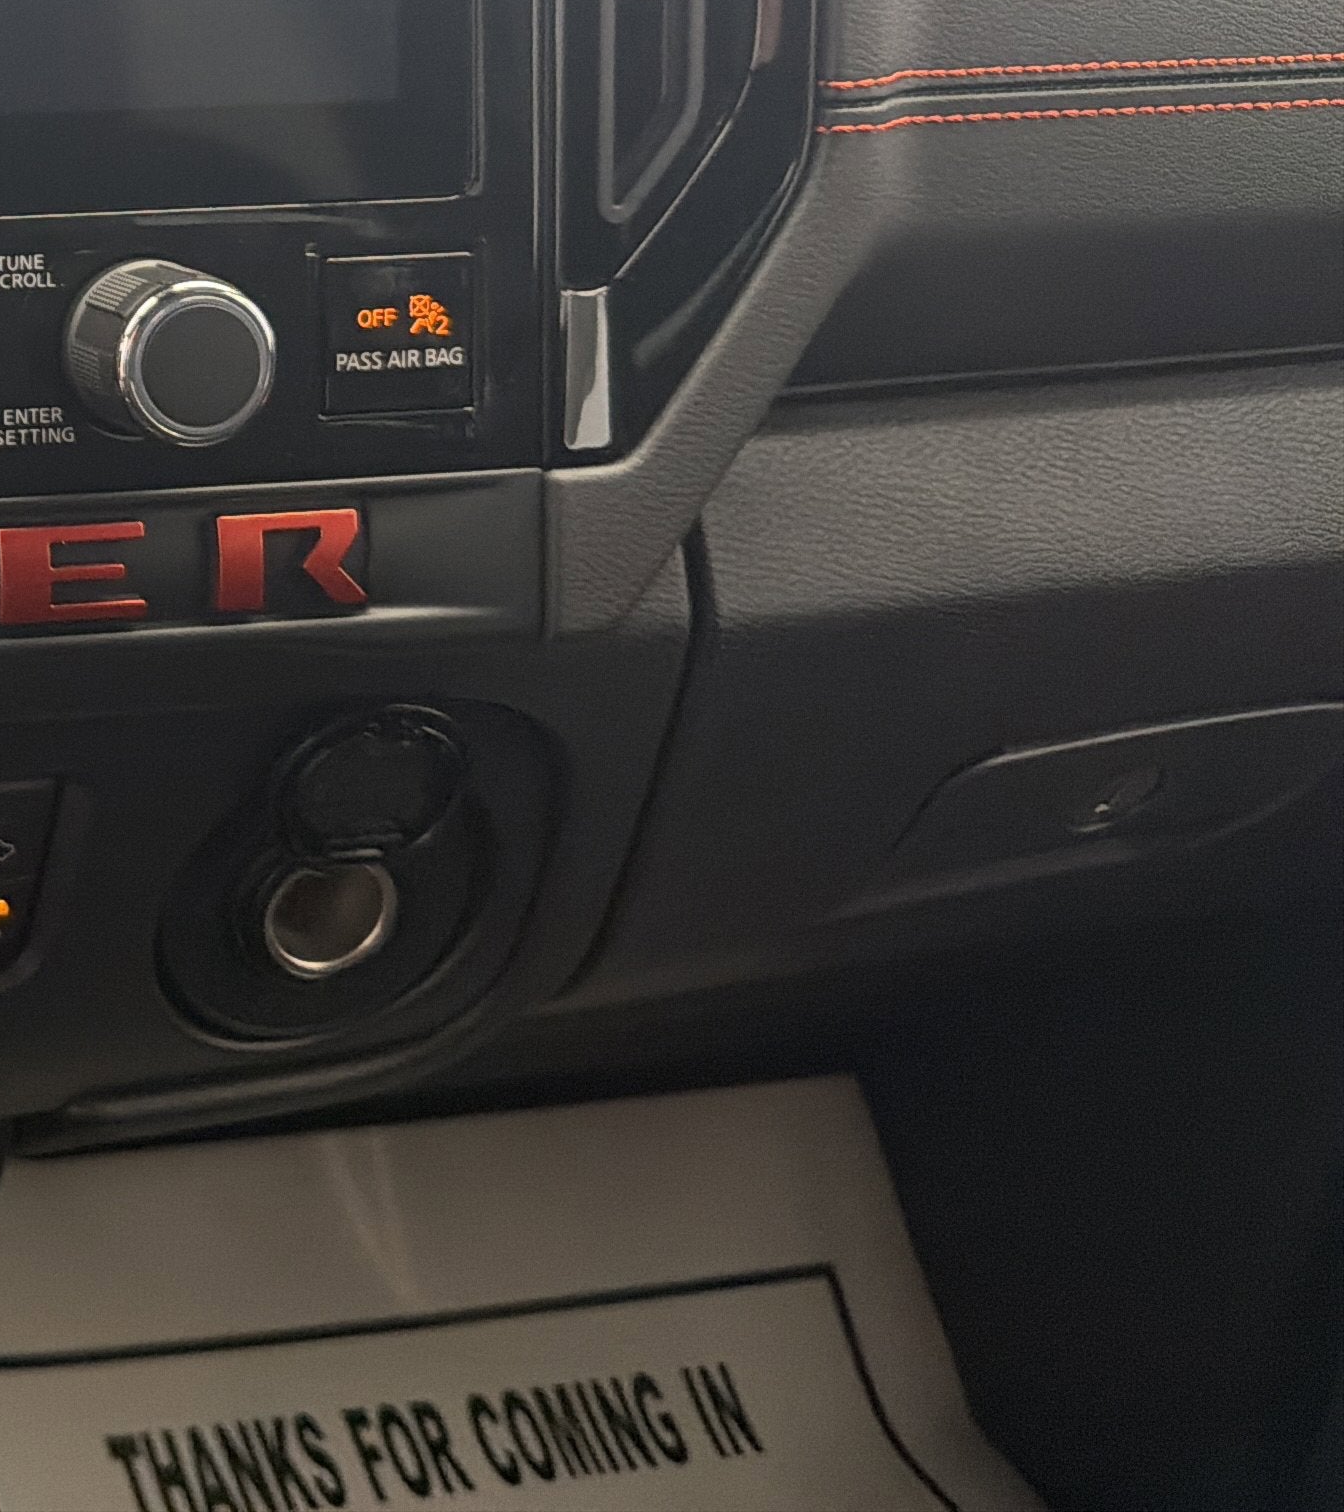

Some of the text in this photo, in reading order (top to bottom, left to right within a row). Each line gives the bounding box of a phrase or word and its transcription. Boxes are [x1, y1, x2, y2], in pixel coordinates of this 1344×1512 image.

[357, 307, 398, 329] OFF
[335, 346, 464, 372] PASS AIR BAG
[2, 406, 63, 426] ENTER
[106, 1361, 764, 1512] THANKS FOR COMING IN
